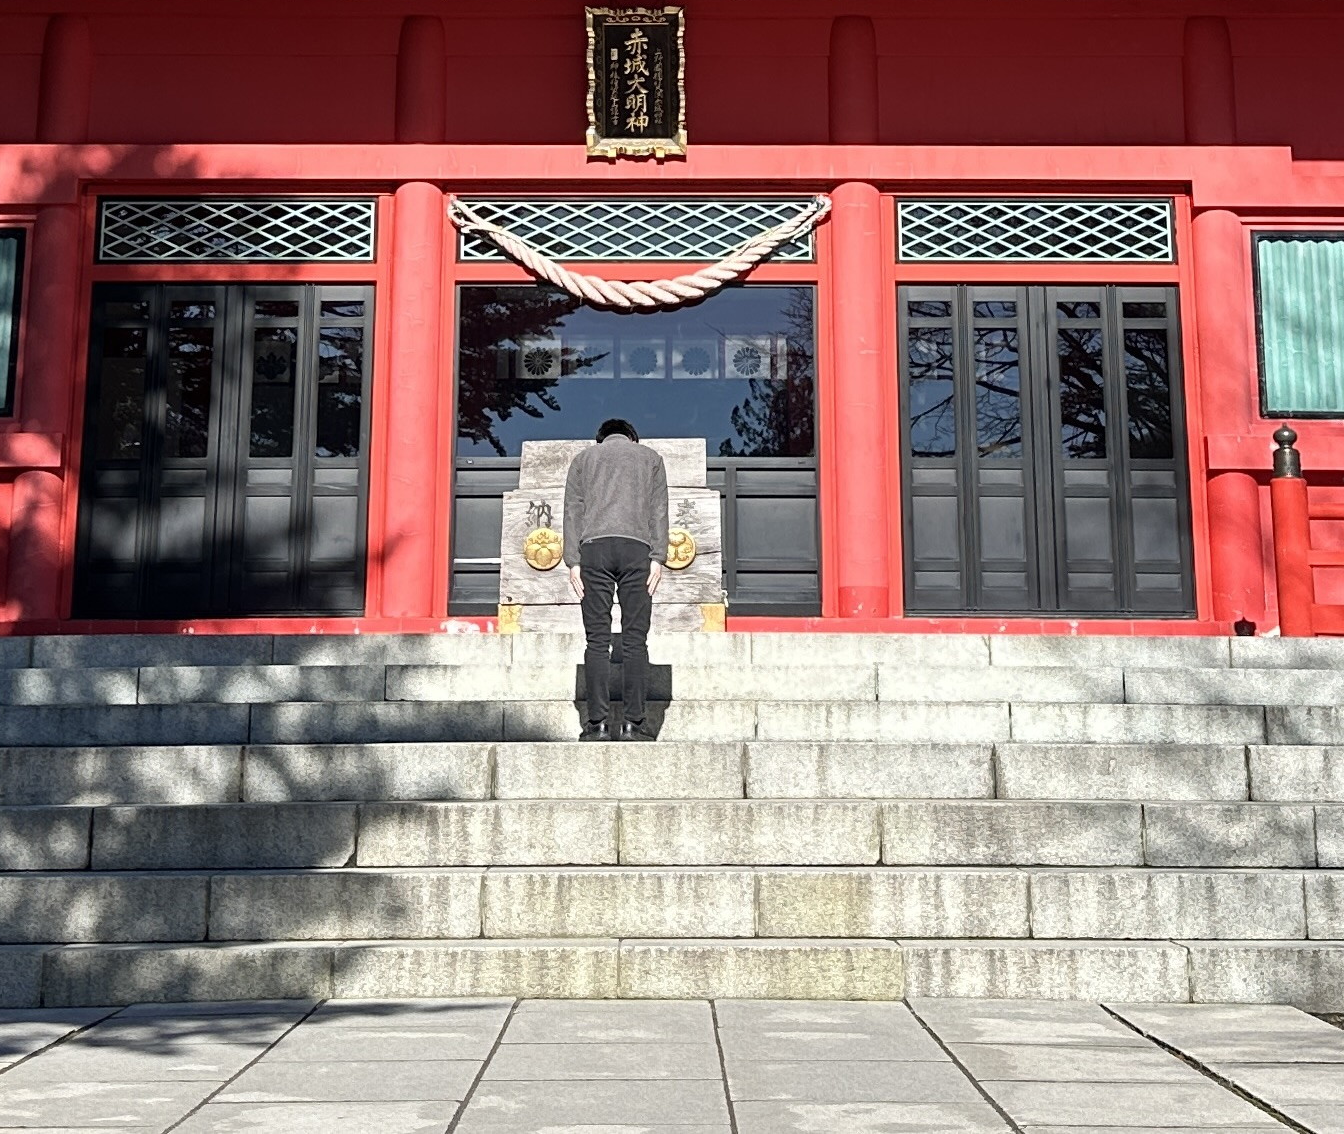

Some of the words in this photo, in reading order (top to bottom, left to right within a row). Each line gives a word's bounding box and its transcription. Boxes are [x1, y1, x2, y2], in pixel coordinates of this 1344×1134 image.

[623, 27, 650, 134] 赤城大明神
[524, 498, 553, 528] 納
[673, 498, 703, 529] 奉
